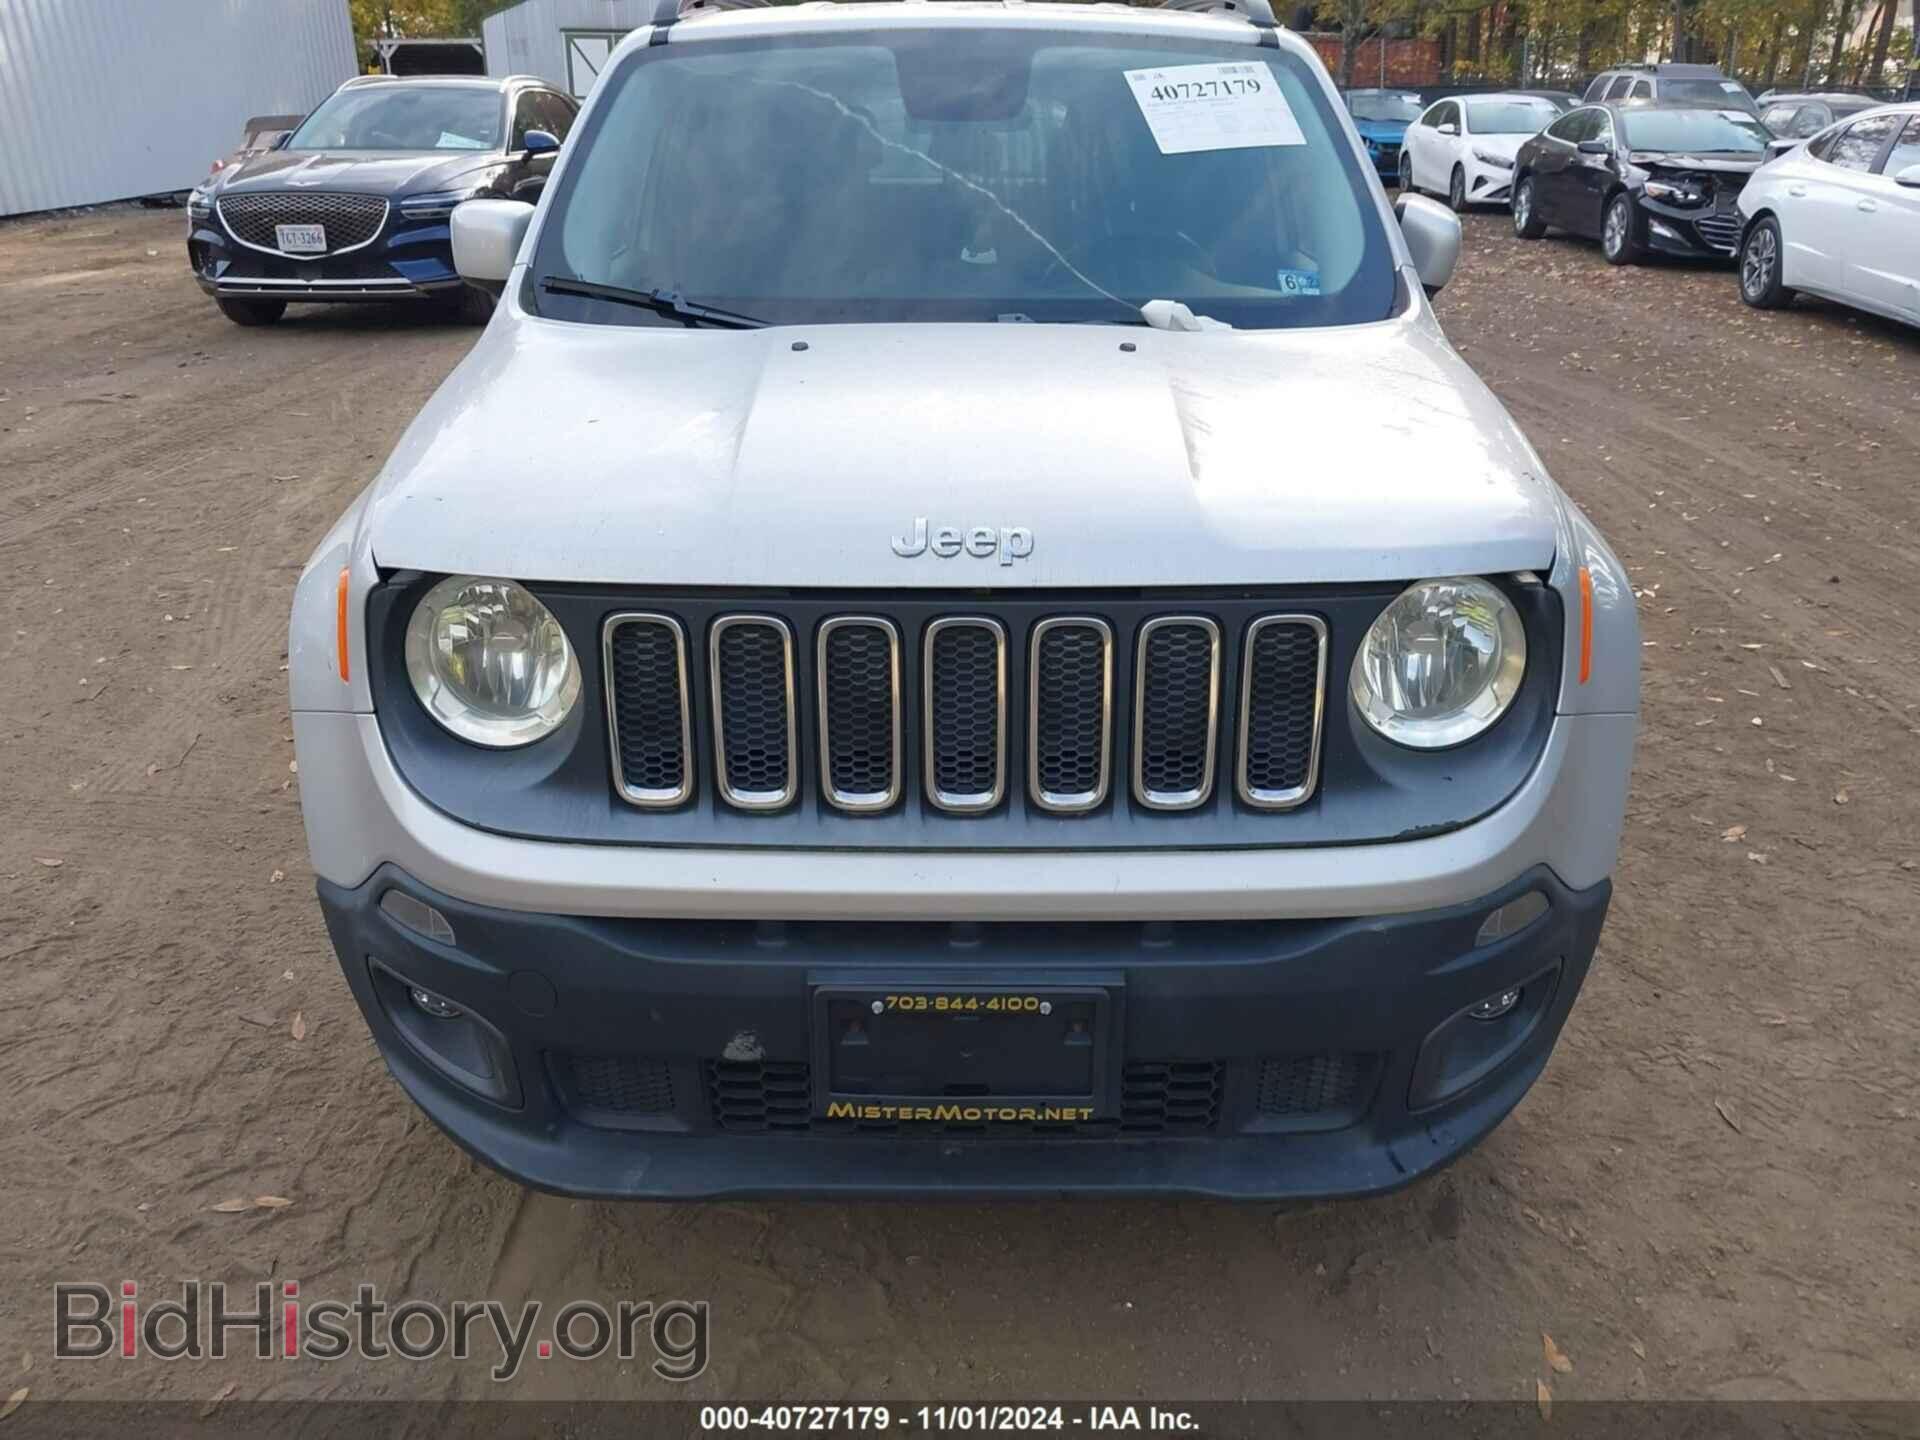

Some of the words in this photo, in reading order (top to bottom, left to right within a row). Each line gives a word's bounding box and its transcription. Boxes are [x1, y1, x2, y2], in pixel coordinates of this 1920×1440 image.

[1151, 78, 1261, 101] 40727179
[1285, 274, 1297, 290] 6
[890, 515, 1035, 567] Jeep
[885, 996, 1039, 1011] 703-844-4100
